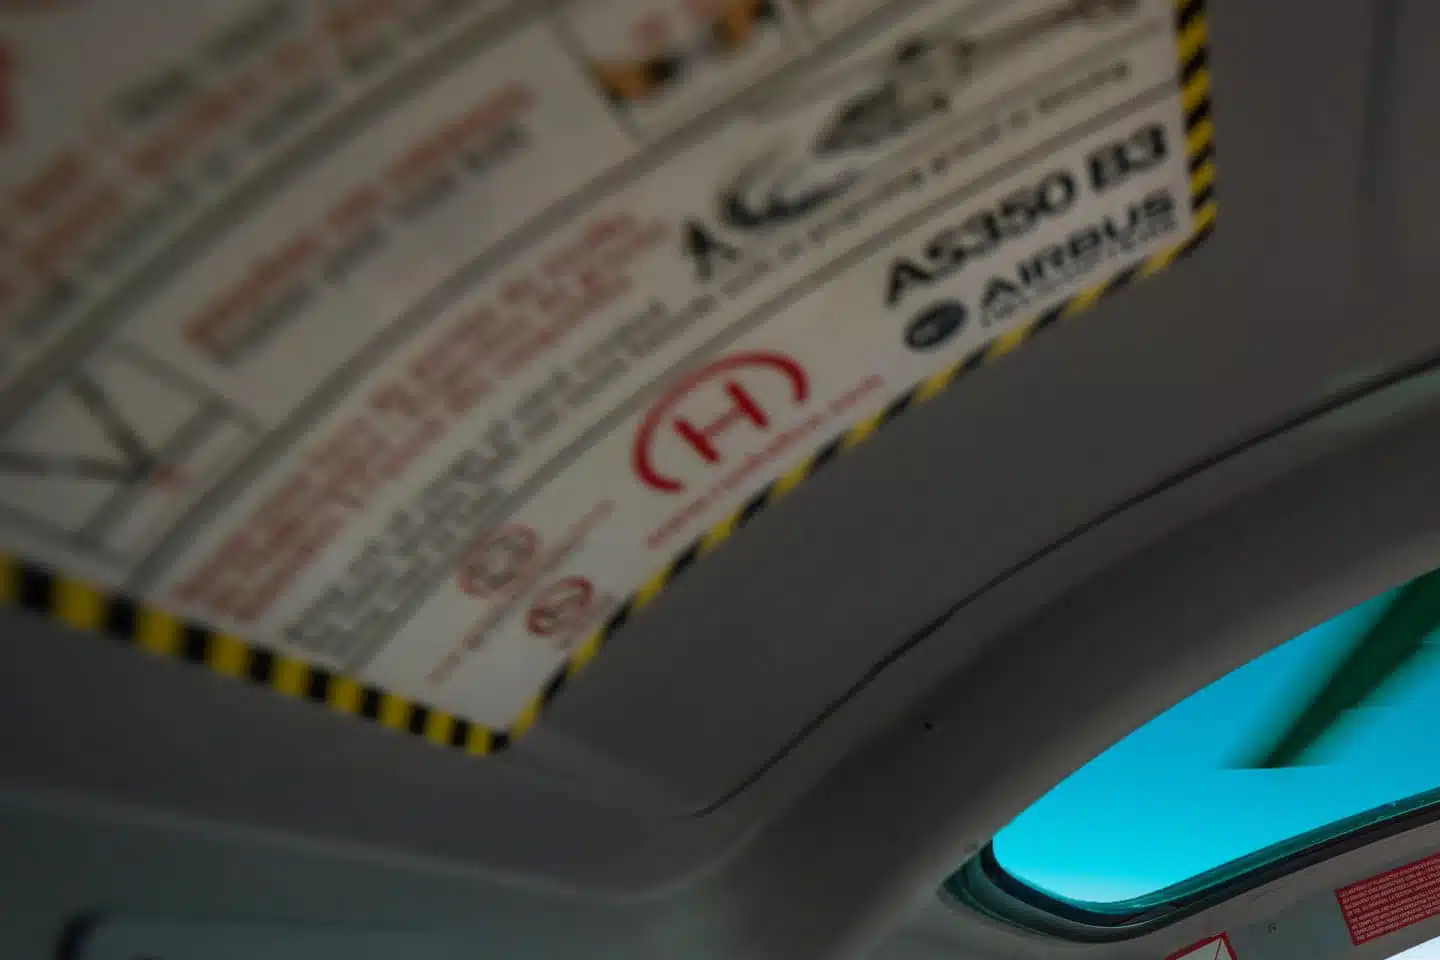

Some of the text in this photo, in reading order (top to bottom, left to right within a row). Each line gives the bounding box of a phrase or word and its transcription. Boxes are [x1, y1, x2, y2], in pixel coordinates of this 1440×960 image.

[885, 168, 1077, 309] AS350
[1087, 121, 1169, 194] B3
[979, 188, 1176, 309] AIRBUS
